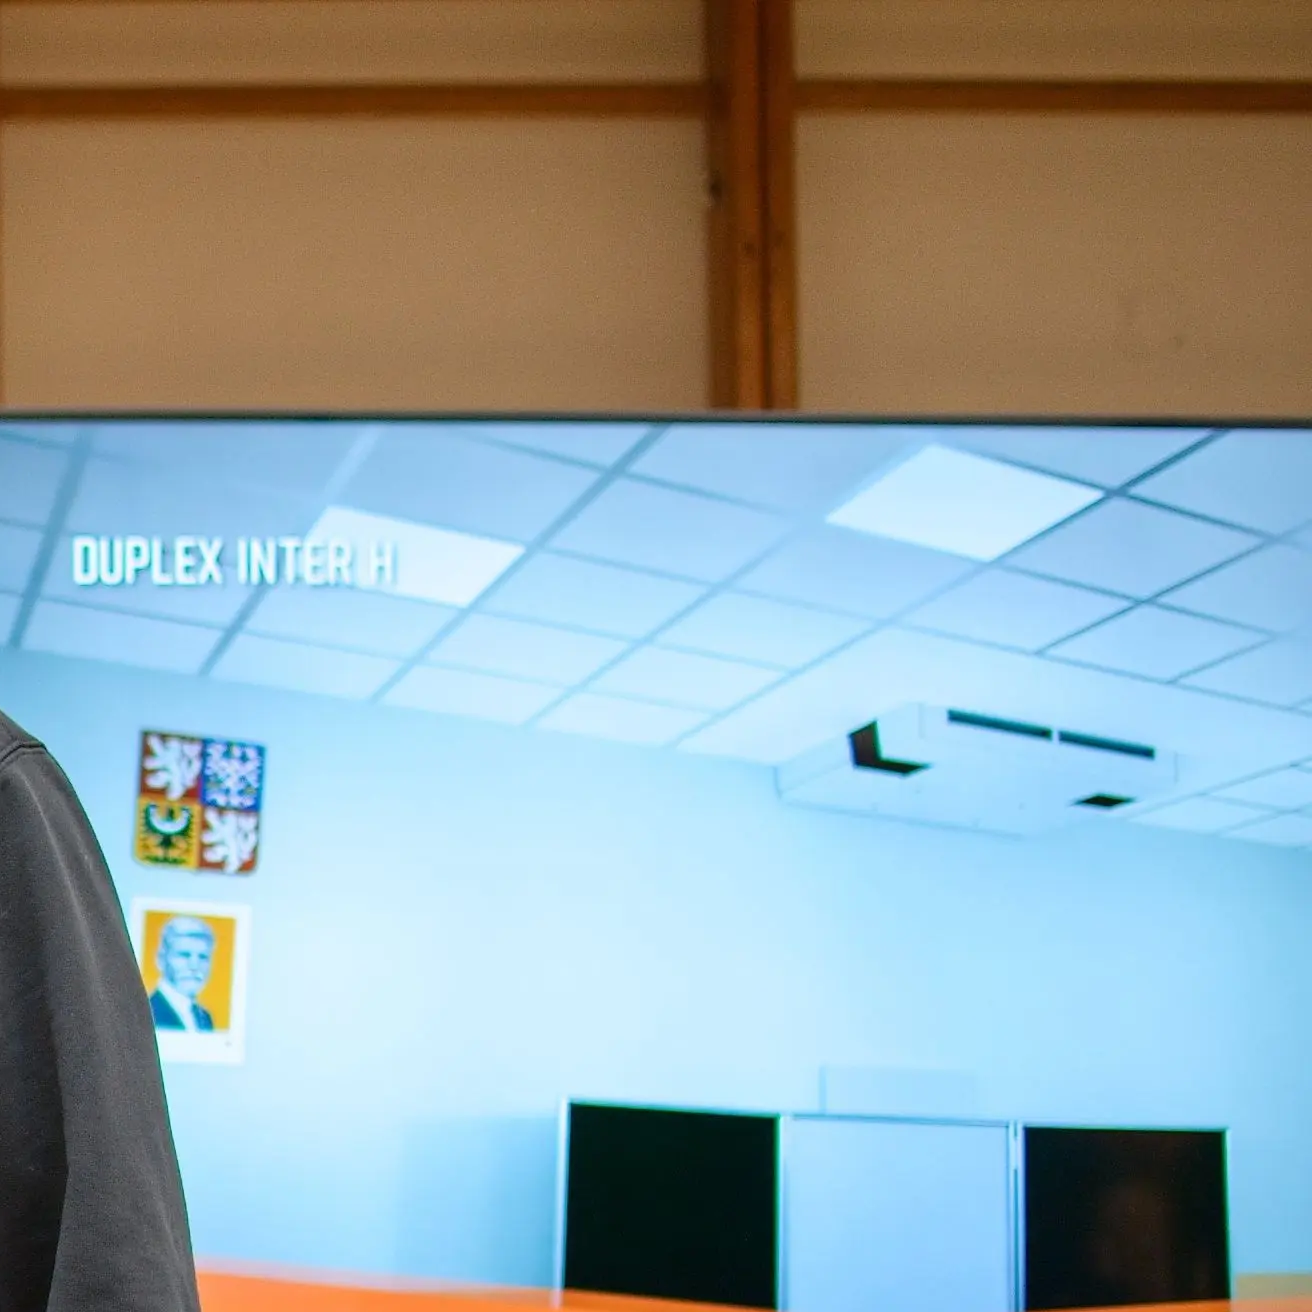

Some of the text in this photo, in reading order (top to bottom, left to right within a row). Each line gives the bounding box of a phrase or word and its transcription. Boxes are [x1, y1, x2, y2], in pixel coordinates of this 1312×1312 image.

[73, 535, 393, 586] DUPLEX INTER H
